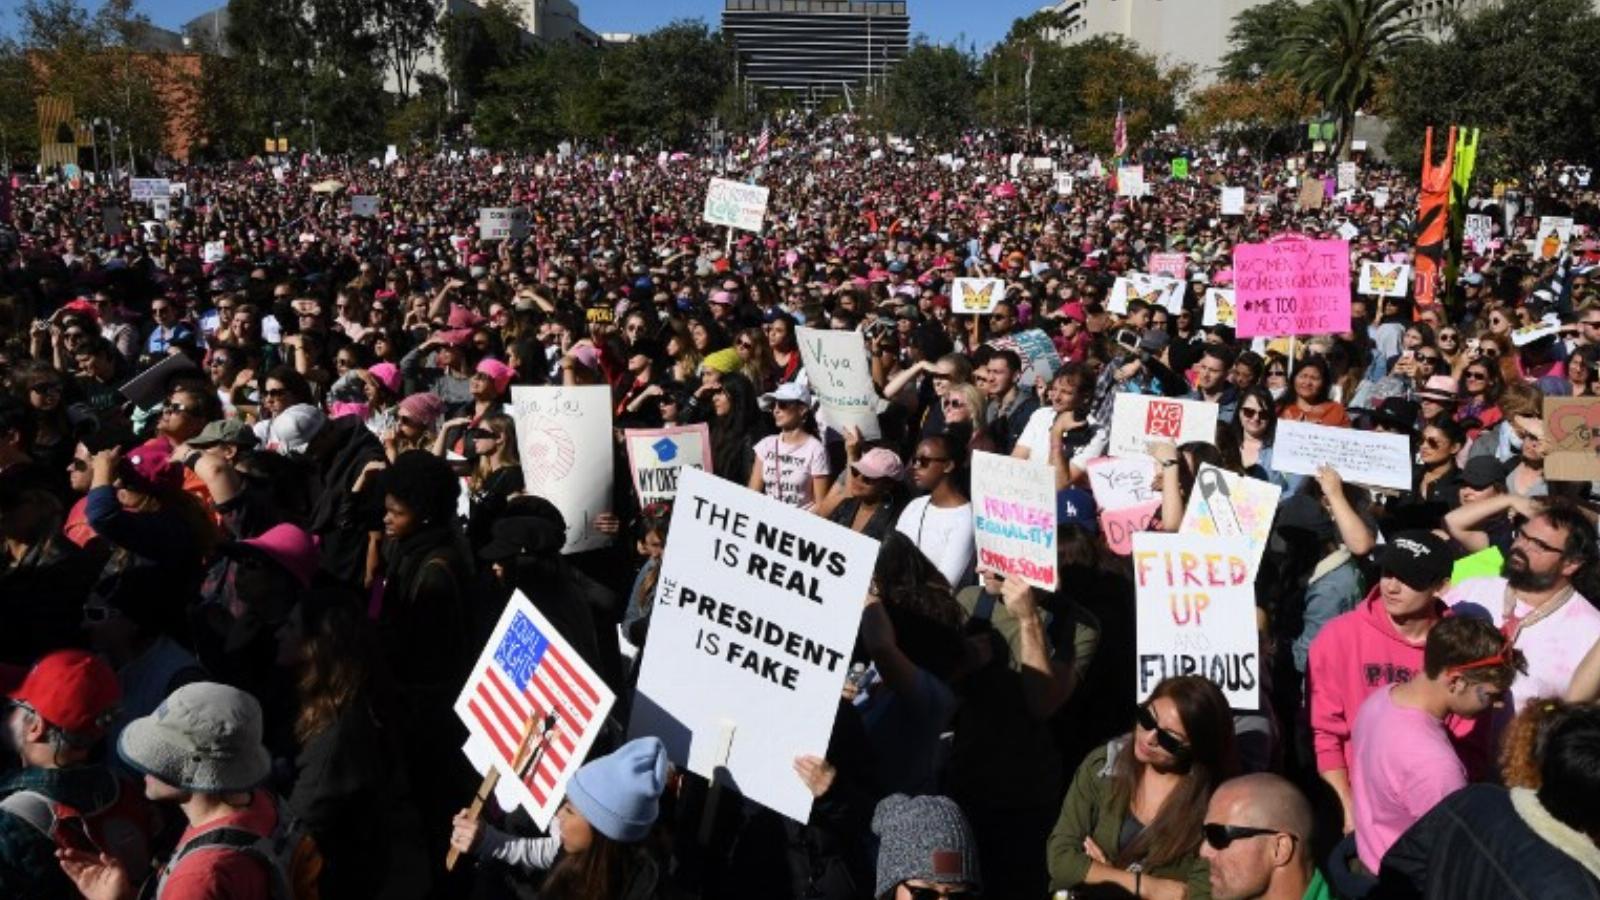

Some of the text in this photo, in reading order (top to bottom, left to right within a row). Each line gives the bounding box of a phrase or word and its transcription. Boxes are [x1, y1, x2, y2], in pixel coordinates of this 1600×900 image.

[1238, 258, 1292, 271] WOMEN
[1275, 295, 1297, 314] TOO
[1295, 314, 1330, 331] WINS
[806, 337, 852, 370] Viva
[638, 468, 654, 492] MY
[693, 495, 848, 578] THE NEWS
[714, 538, 824, 605] IS REAL
[1135, 551, 1248, 587] FIRED
[659, 576, 845, 673] THE PRESIDENT
[1170, 592, 1211, 626] UP
[510, 611, 540, 656] EQUAL
[695, 628, 800, 691] IS FAKE
